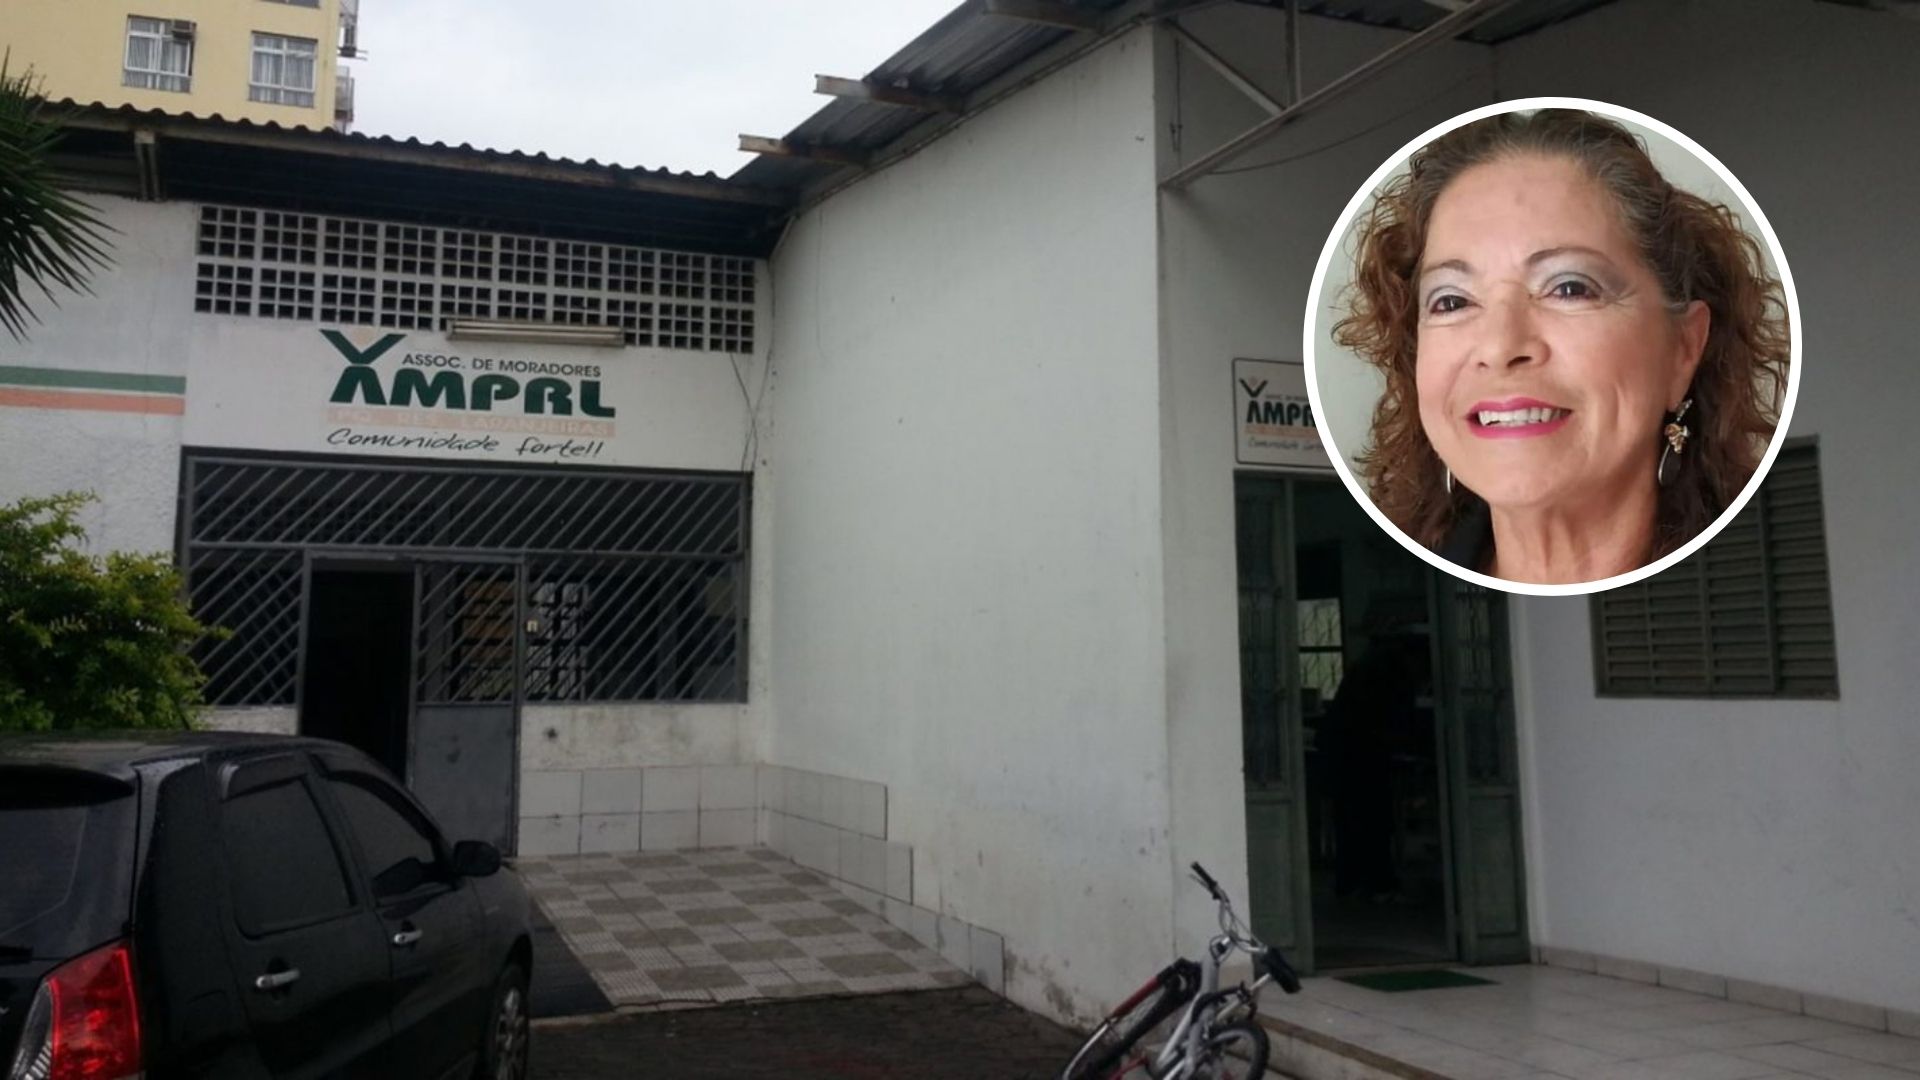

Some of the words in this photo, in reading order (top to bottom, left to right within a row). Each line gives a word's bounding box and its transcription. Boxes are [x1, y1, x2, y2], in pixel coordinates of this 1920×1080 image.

[402, 353, 466, 369] ASSOC.
[472, 357, 493, 371] DE
[499, 359, 601, 378] MORADORES
[329, 366, 616, 418] AMPRL
[461, 416, 608, 436] LARANJEIRAS
[327, 427, 499, 451] Comunidade
